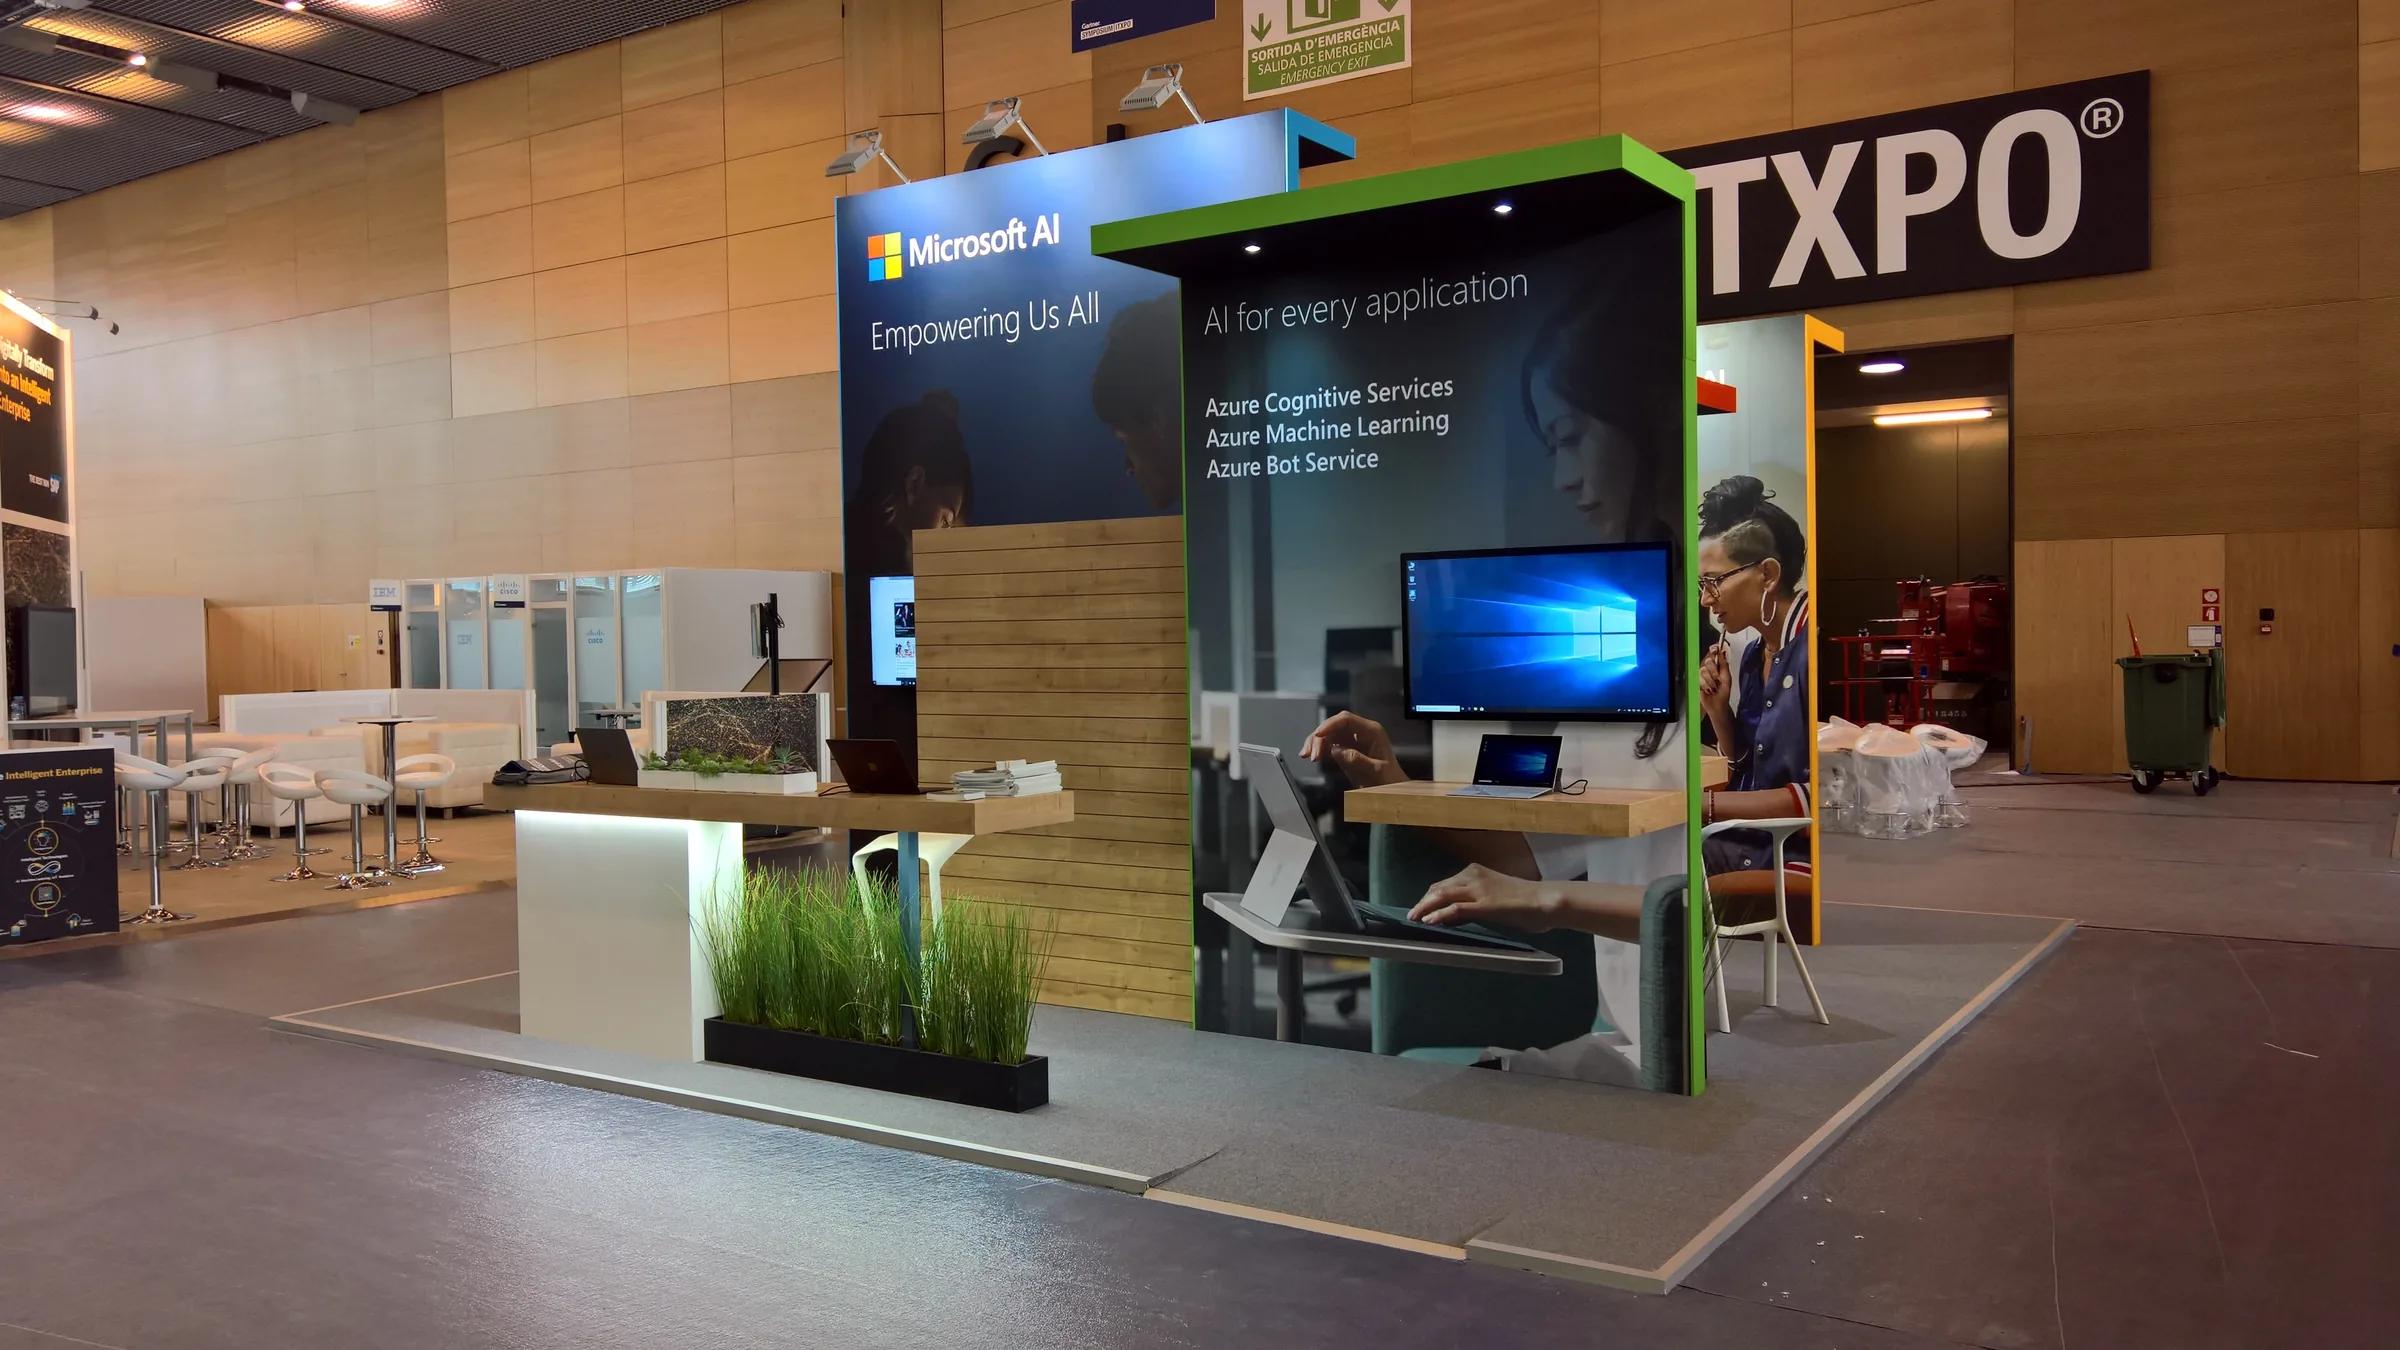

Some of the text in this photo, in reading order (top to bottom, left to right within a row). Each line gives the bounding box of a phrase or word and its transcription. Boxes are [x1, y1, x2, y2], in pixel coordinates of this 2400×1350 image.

[1251, 44, 1301, 63] SORTIDA
[1258, 36, 1393, 76] SALIDA DE EMERGENCIA
[1280, 54, 1371, 85] EMERGENCY EXIT
[909, 212, 1060, 267] Microsoft AI
[1204, 270, 1528, 335] AI for every application
[872, 290, 1100, 355] Empowering Us All
[23, 347, 54, 381] Transform
[20, 373, 51, 406] Intelligent
[1205, 377, 1454, 418] Azure Cognitive Services
[1206, 409, 1449, 449] Azure Machine Learning
[1206, 448, 1379, 479] Azure Bot Service
[373, 587, 396, 597] IBM
[6, 769, 54, 780] Intelligent
[56, 767, 103, 777] Enterprise
